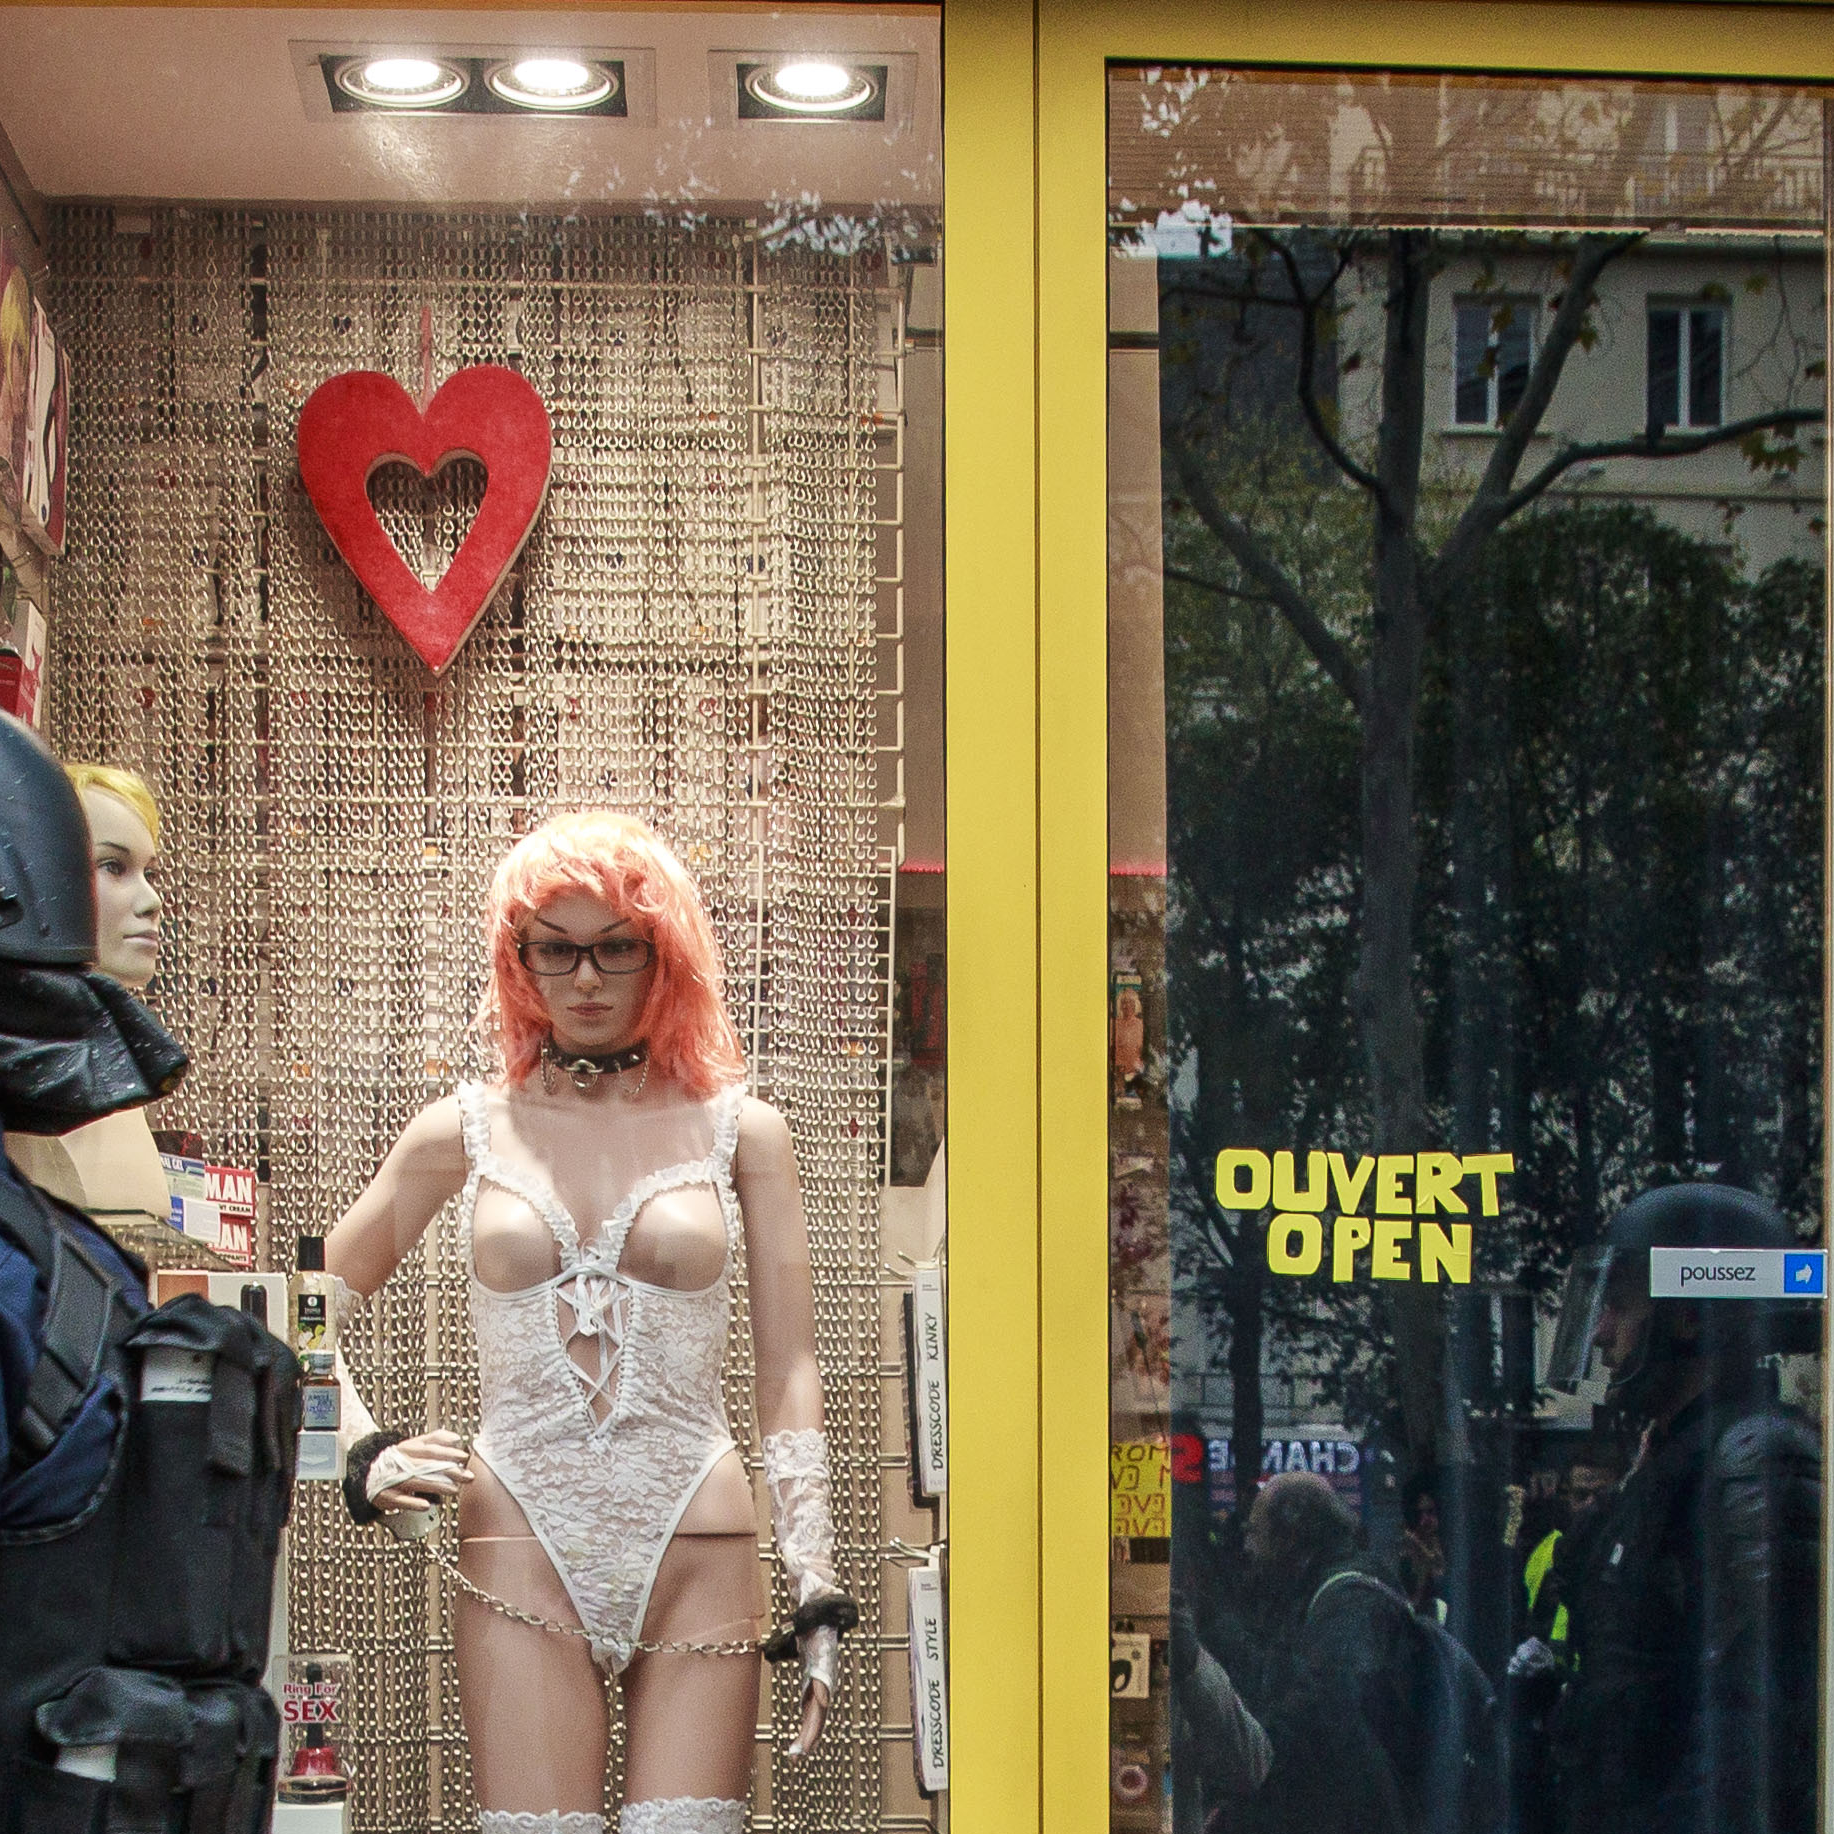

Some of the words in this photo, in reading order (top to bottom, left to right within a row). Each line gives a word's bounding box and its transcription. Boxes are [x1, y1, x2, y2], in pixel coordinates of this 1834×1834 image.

[206, 1172, 253, 1203] MAN
[1216, 1148, 1515, 1216] OUVERT
[1267, 1214, 1473, 1284] OPEN
[1680, 1262, 1756, 1287] poussez
[925, 1311, 939, 1362] KINKY
[927, 1379, 944, 1471] DRESSCODE
[924, 1617, 939, 1662] STYLE
[283, 1683, 311, 1694] Ring
[316, 1683, 337, 1694] For
[283, 1700, 337, 1721] SEX
[927, 1679, 944, 1769] DRESSCODE
